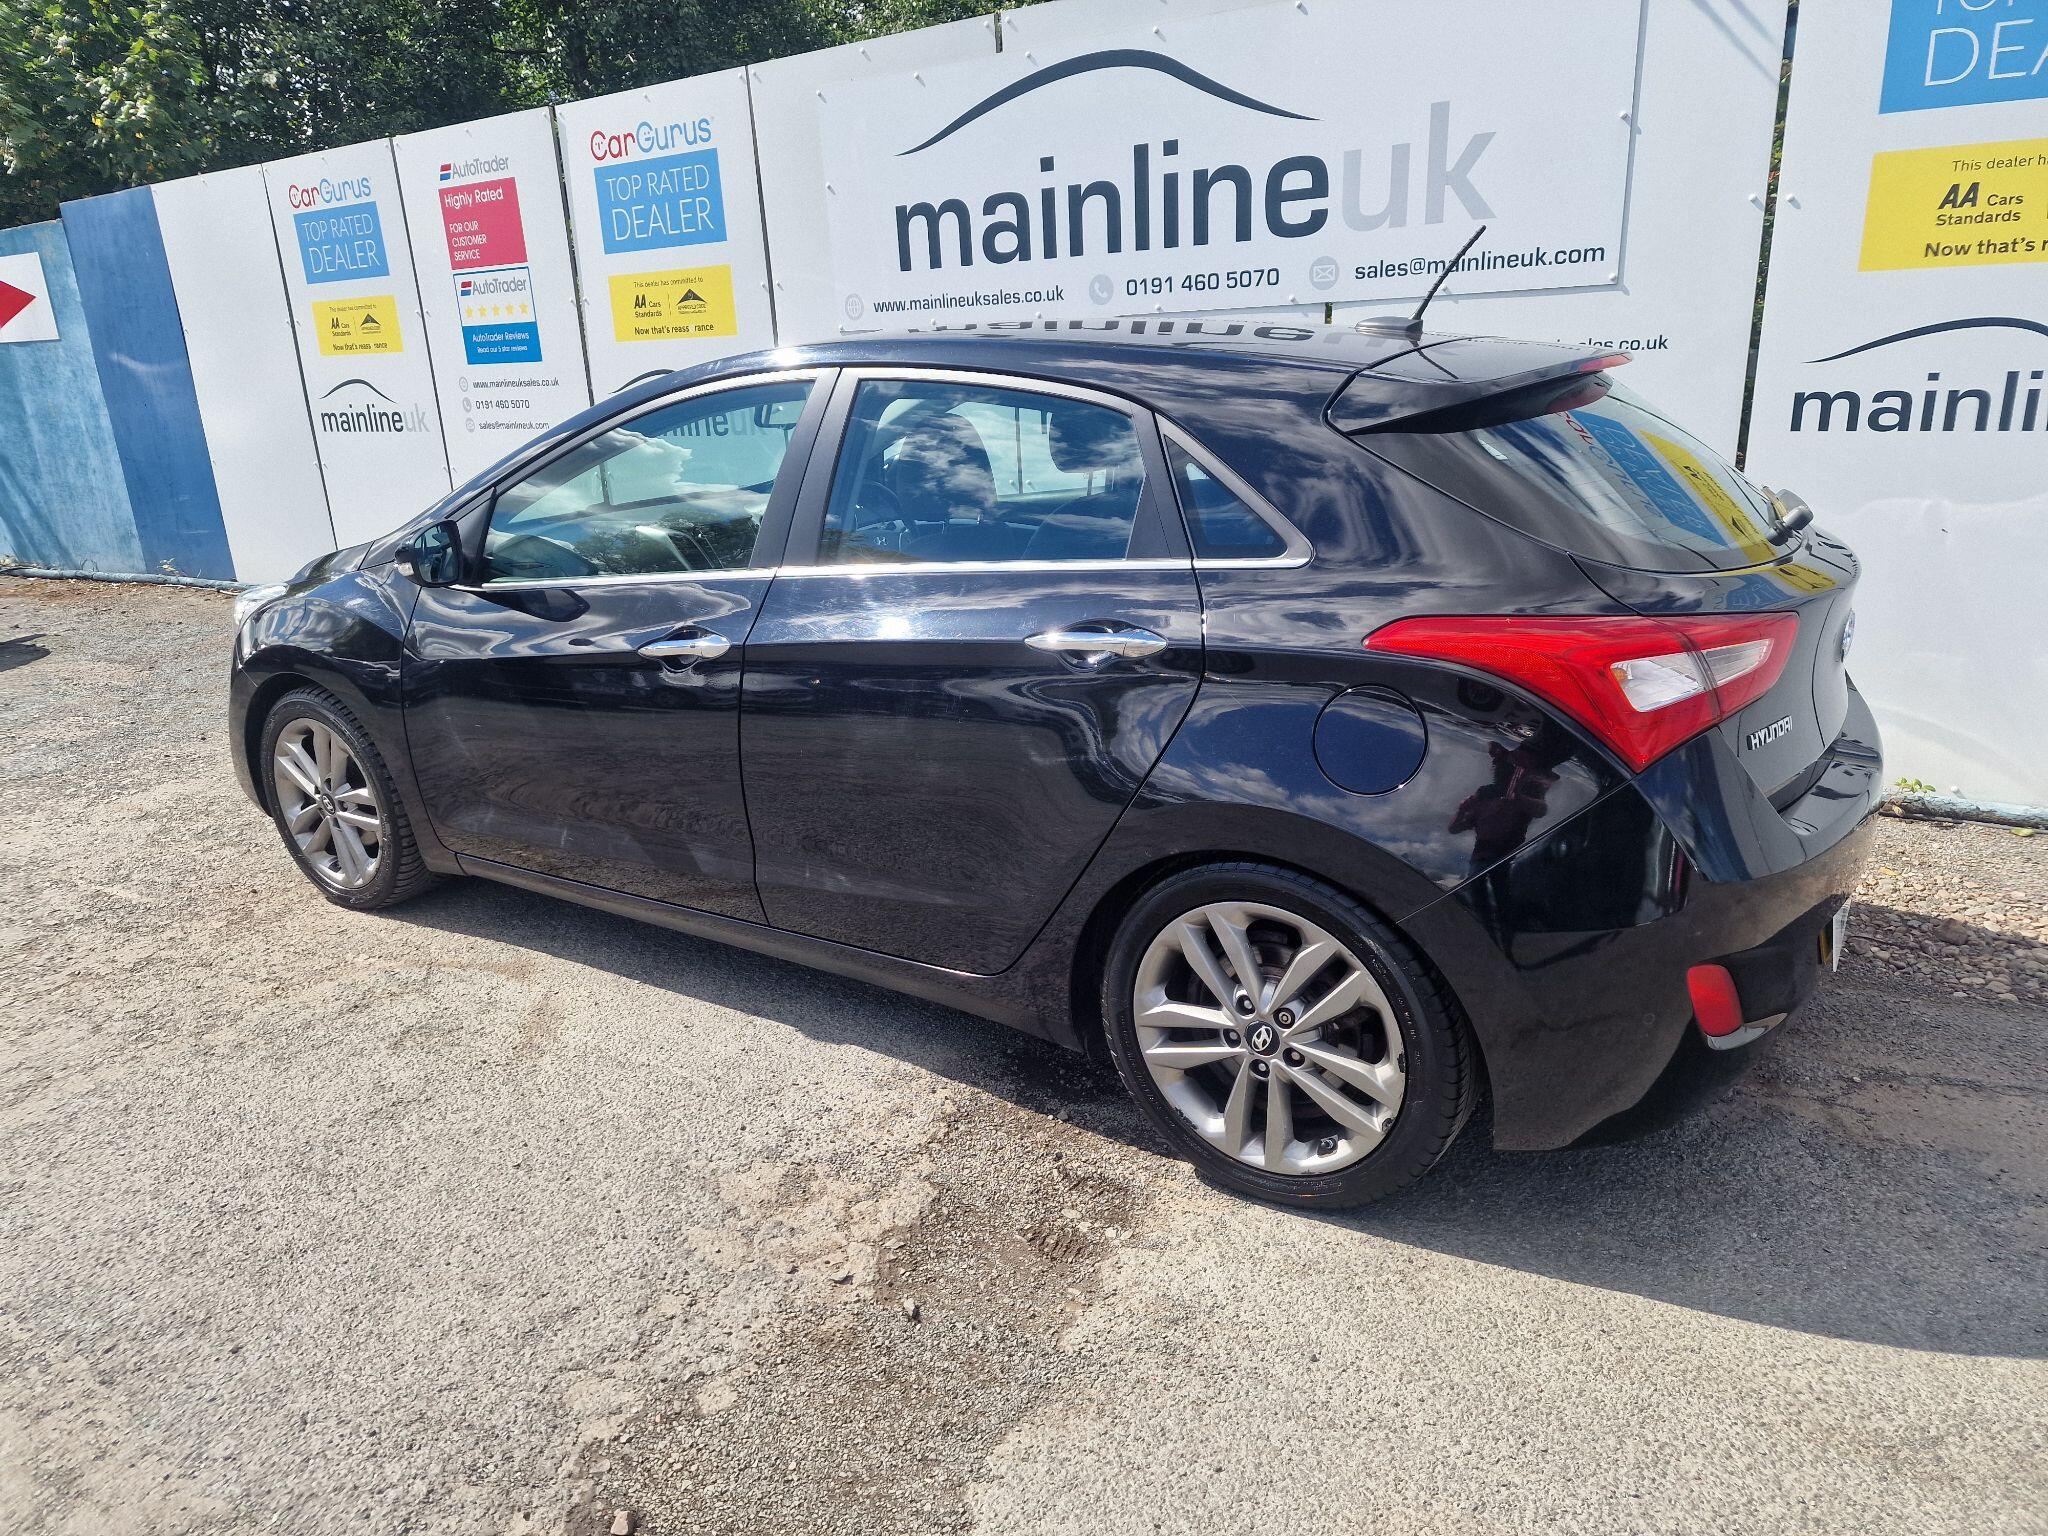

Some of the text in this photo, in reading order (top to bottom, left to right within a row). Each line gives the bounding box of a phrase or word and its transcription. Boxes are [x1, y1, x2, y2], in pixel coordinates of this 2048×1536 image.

[589, 117, 712, 161] CarGurus
[452, 155, 509, 179] AutoTrader
[1952, 160, 1982, 172] This
[1986, 155, 2035, 170] dealer
[289, 177, 371, 209] CarGurus
[605, 164, 710, 202] TOP RATED
[894, 100, 1498, 272] mainlineuk
[444, 185, 504, 210] Highly Rated
[1937, 181, 2024, 210] AA Cars
[301, 213, 374, 242] TOP RATED
[449, 220, 479, 234] FOR OUR
[612, 197, 715, 241] DEALER
[1935, 210, 2021, 226] Standards
[452, 233, 487, 248] CUSTOMER
[1924, 241, 1972, 258] Now
[1977, 236, 2036, 255] that's
[309, 239, 381, 274] DEALER
[454, 248, 481, 261] SERVICE
[472, 277, 527, 296] AutoTrader
[1126, 267, 1281, 297] 0191 460 5070
[634, 294, 661, 309] AA Cars
[873, 285, 1065, 313] www.mainlineuksales.co.uk
[331, 317, 340, 329] AA
[635, 310, 662, 319] Standards
[504, 331, 530, 341] Reviews
[634, 326, 650, 336] Now
[510, 399, 530, 409] 5070
[320, 403, 430, 433] mainlineuk
[1750, 715, 1794, 750] HYUNDAI
